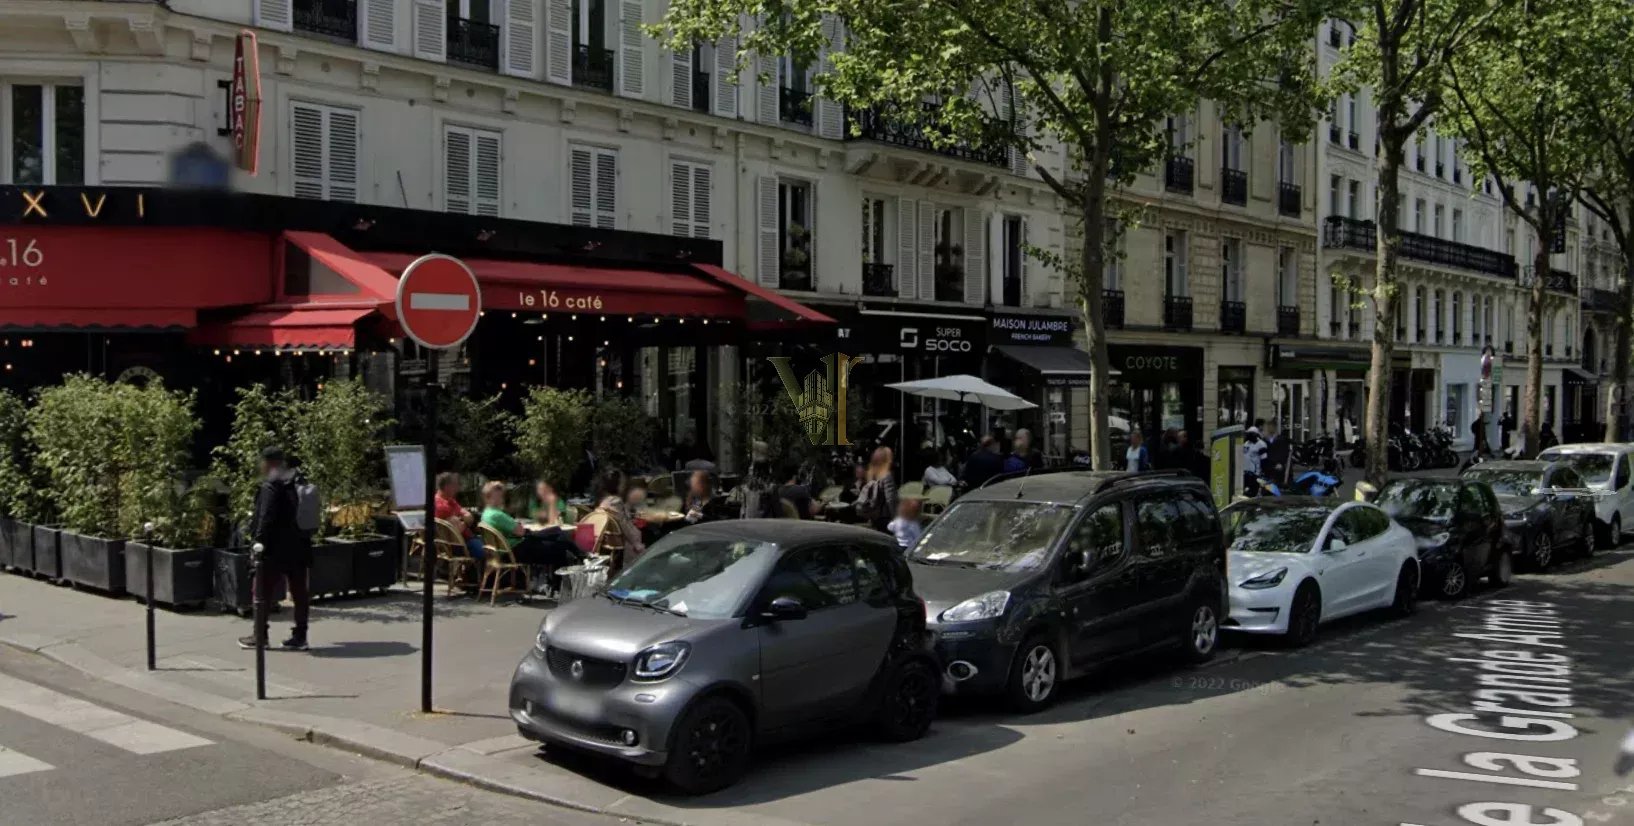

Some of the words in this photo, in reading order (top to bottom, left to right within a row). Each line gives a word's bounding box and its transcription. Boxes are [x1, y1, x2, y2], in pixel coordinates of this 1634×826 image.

[235, 56, 245, 149] TABAC
[7, 238, 44, 267] 16
[0, 276, 48, 286] afé
[519, 292, 535, 306] le
[540, 290, 560, 308] 16
[565, 295, 603, 310] café
[936, 327, 962, 337] SUPER
[993, 318, 1026, 330] MAISON
[1027, 320, 1068, 332] JULAMBRE
[925, 339, 971, 352] SOCO
[1125, 355, 1177, 369] COYOTE
